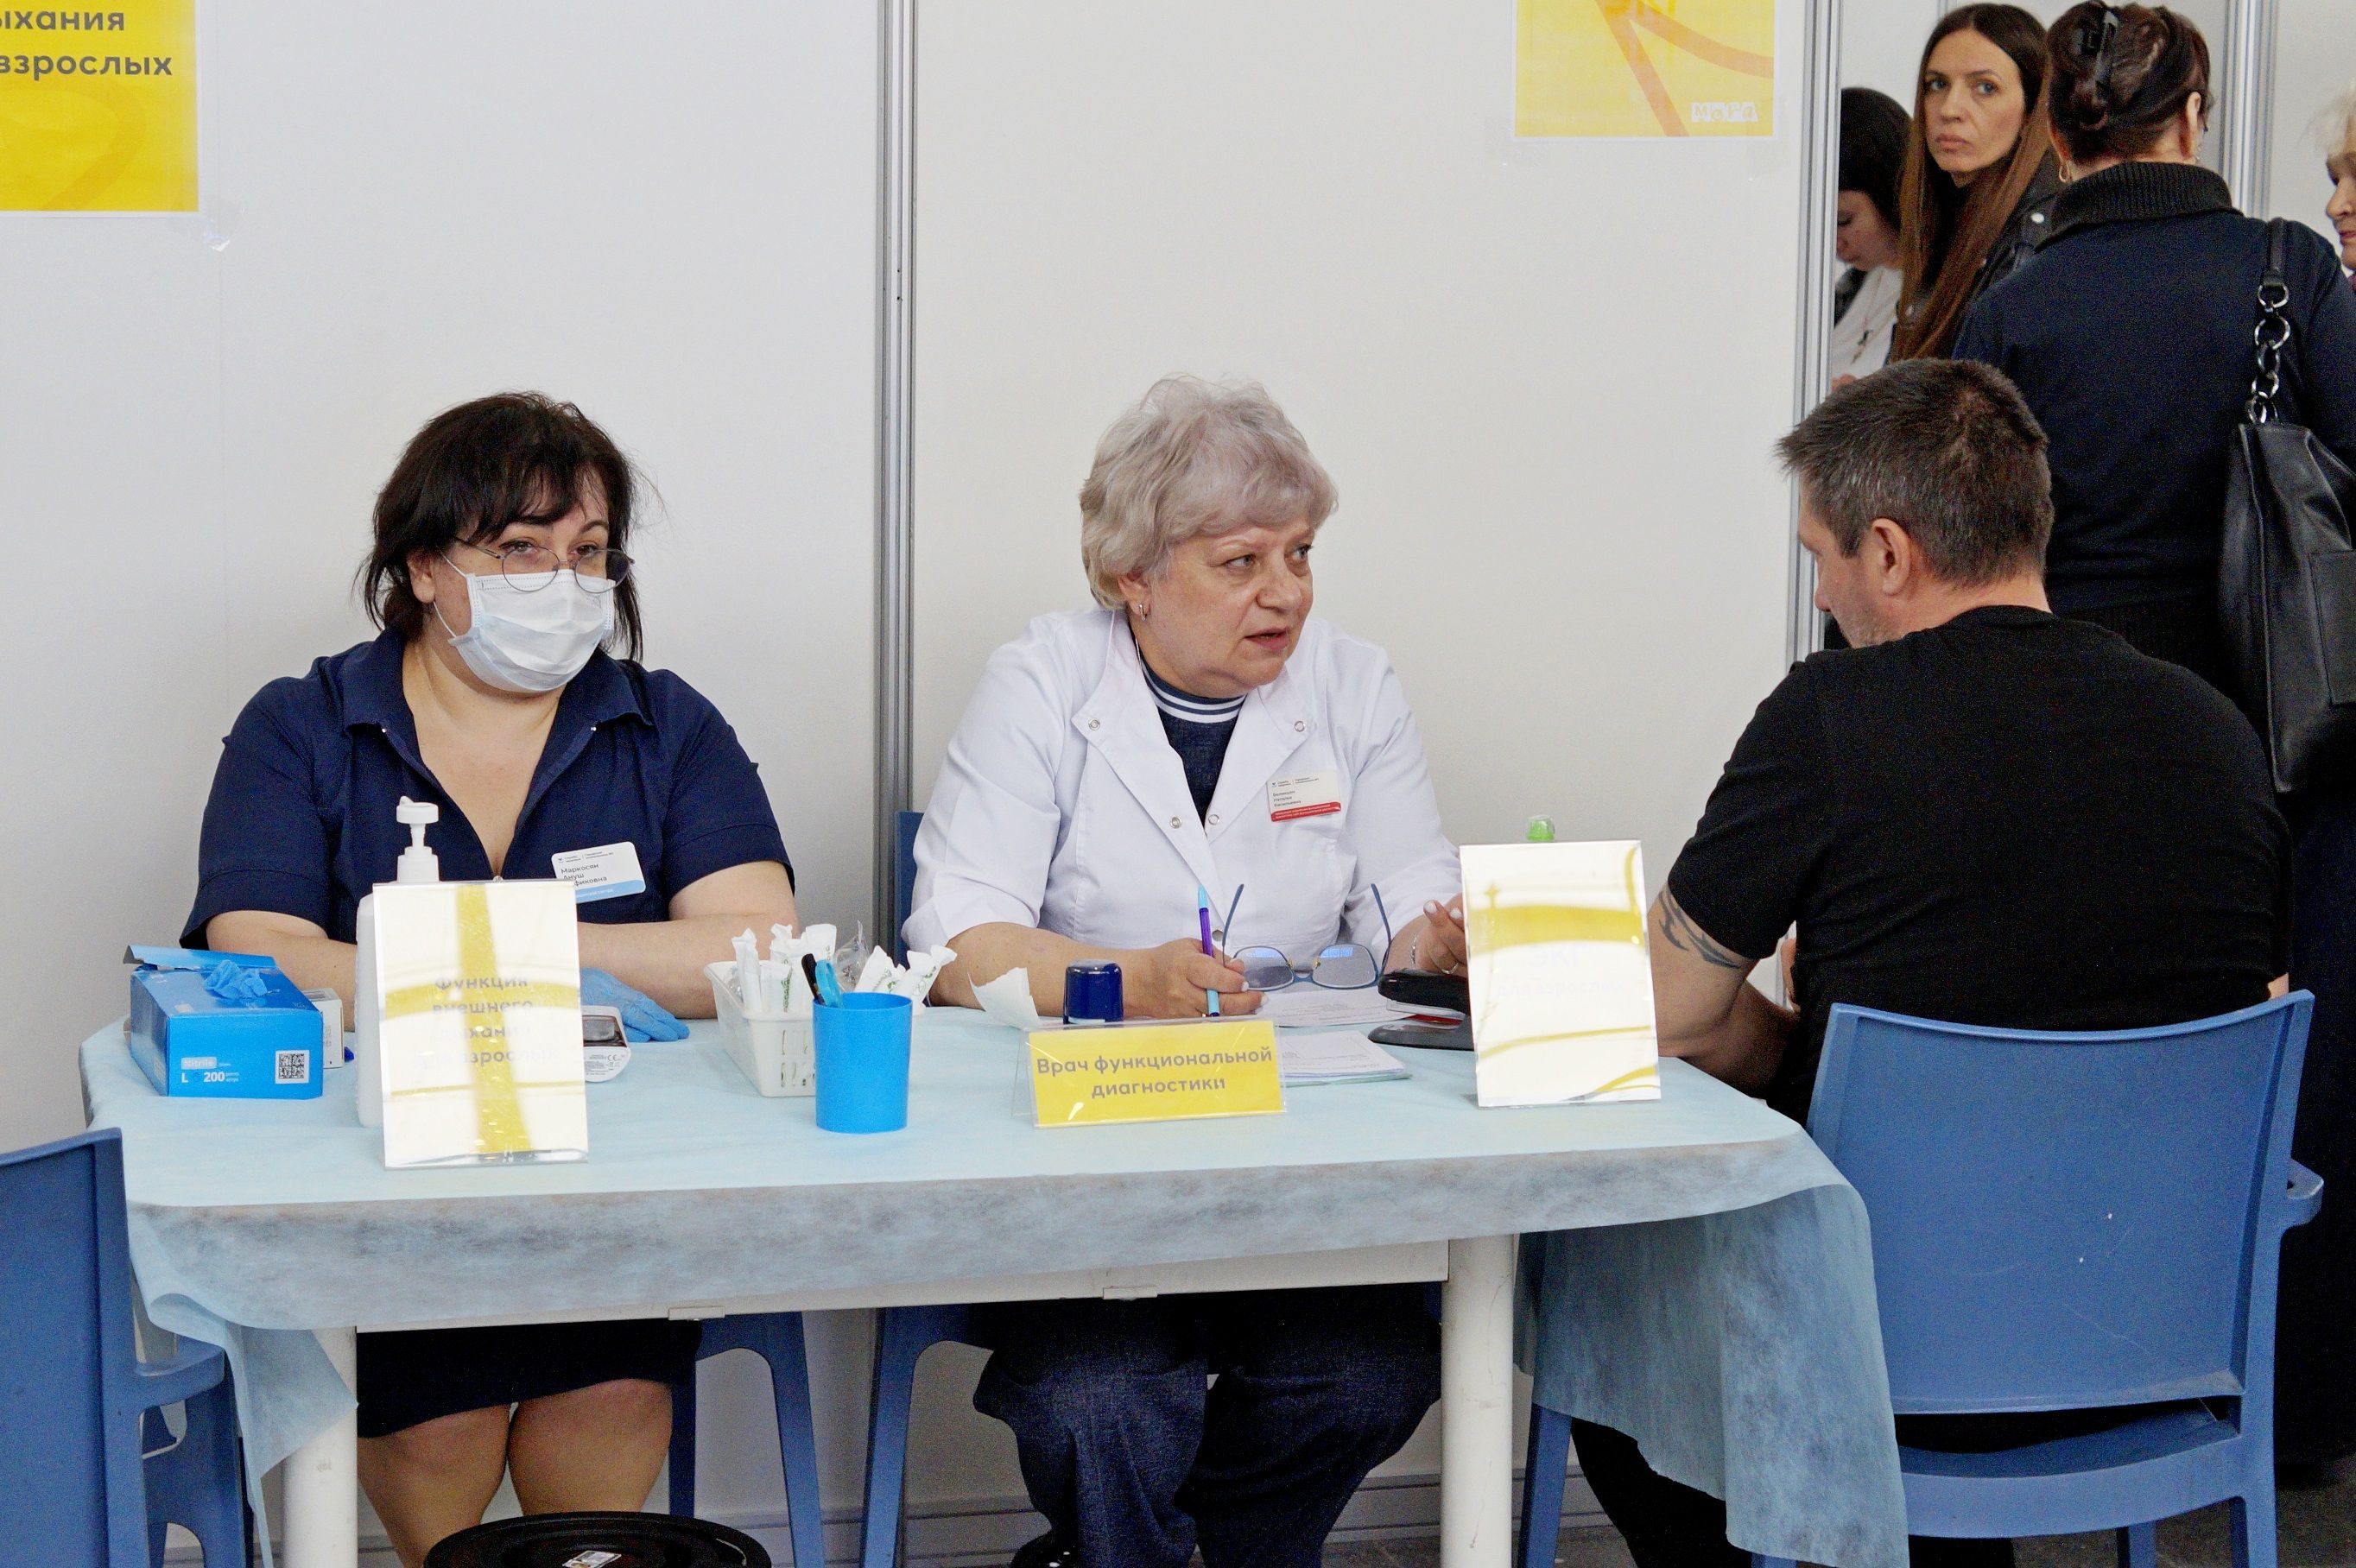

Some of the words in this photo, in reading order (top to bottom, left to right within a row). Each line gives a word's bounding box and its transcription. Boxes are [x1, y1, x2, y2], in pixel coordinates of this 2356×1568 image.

[0, 54, 173, 81] взрослых
[560, 863, 599, 875] Маркосян
[573, 876, 608, 887] фиковна
[1036, 1057, 1088, 1077] Врач
[1093, 1046, 1272, 1075] функциональной
[181, 1072, 189, 1084] L
[203, 1071, 225, 1083] 200
[1091, 1077, 1226, 1099] диагностики
